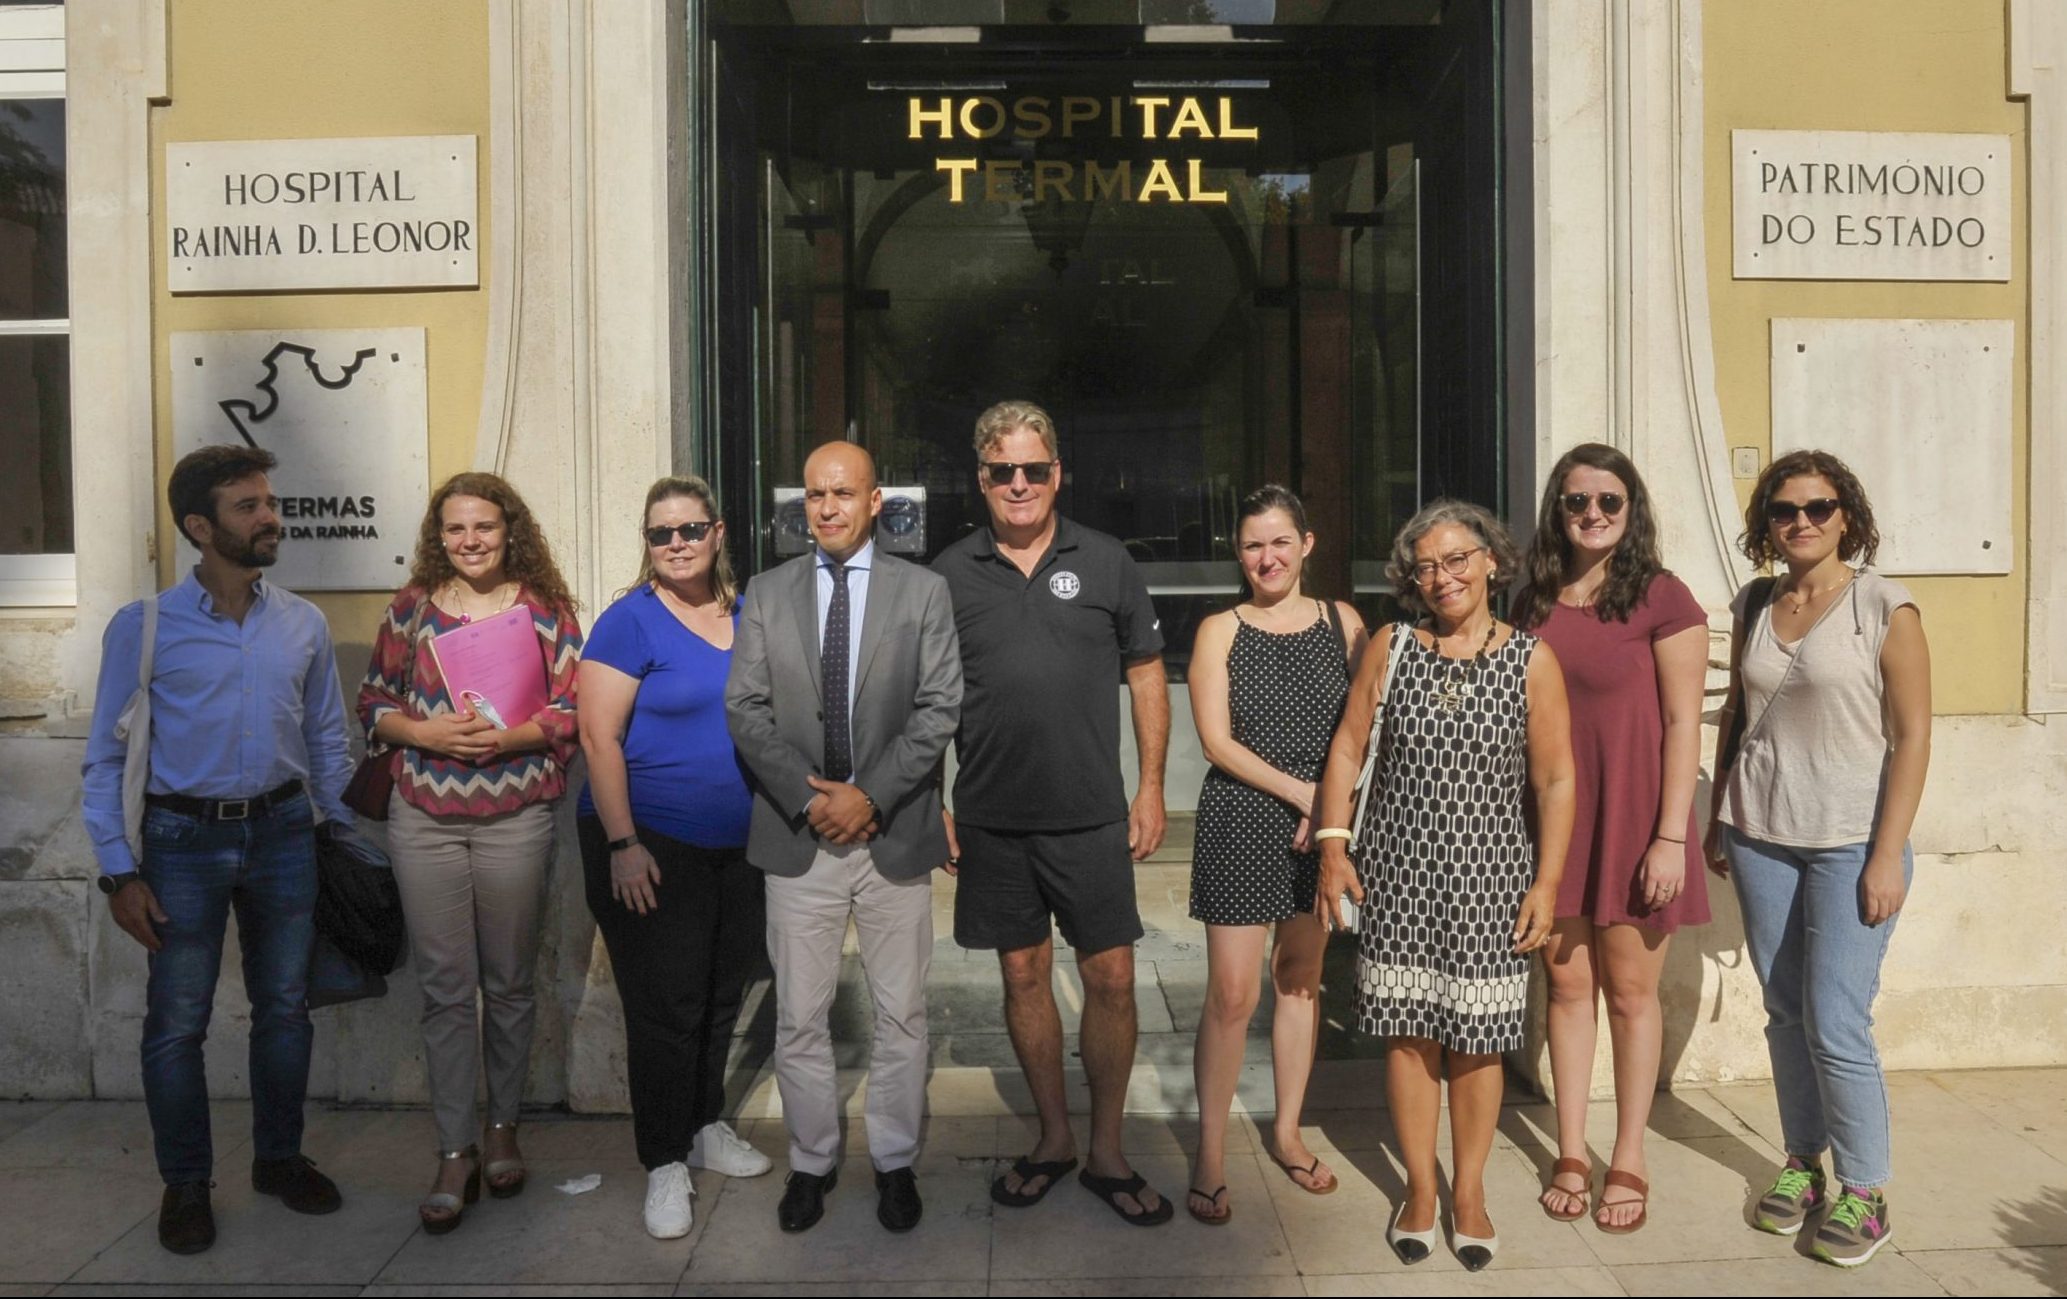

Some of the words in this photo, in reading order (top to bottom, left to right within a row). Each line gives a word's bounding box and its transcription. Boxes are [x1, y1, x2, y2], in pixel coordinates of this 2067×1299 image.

[908, 96, 1258, 140] HOSPITAL
[224, 170, 416, 206] HOSPITAL
[935, 157, 1228, 204] TERMAL
[1760, 158, 1986, 197] PATRIMÓNIO
[172, 224, 282, 258] RAINHA
[332, 219, 472, 254] LEONOR
[1761, 214, 1816, 245] DO
[1835, 214, 1986, 248] ESTADO
[278, 496, 376, 519] ERMAS
[290, 525, 314, 540] DA
[316, 524, 379, 540] RAINHA
